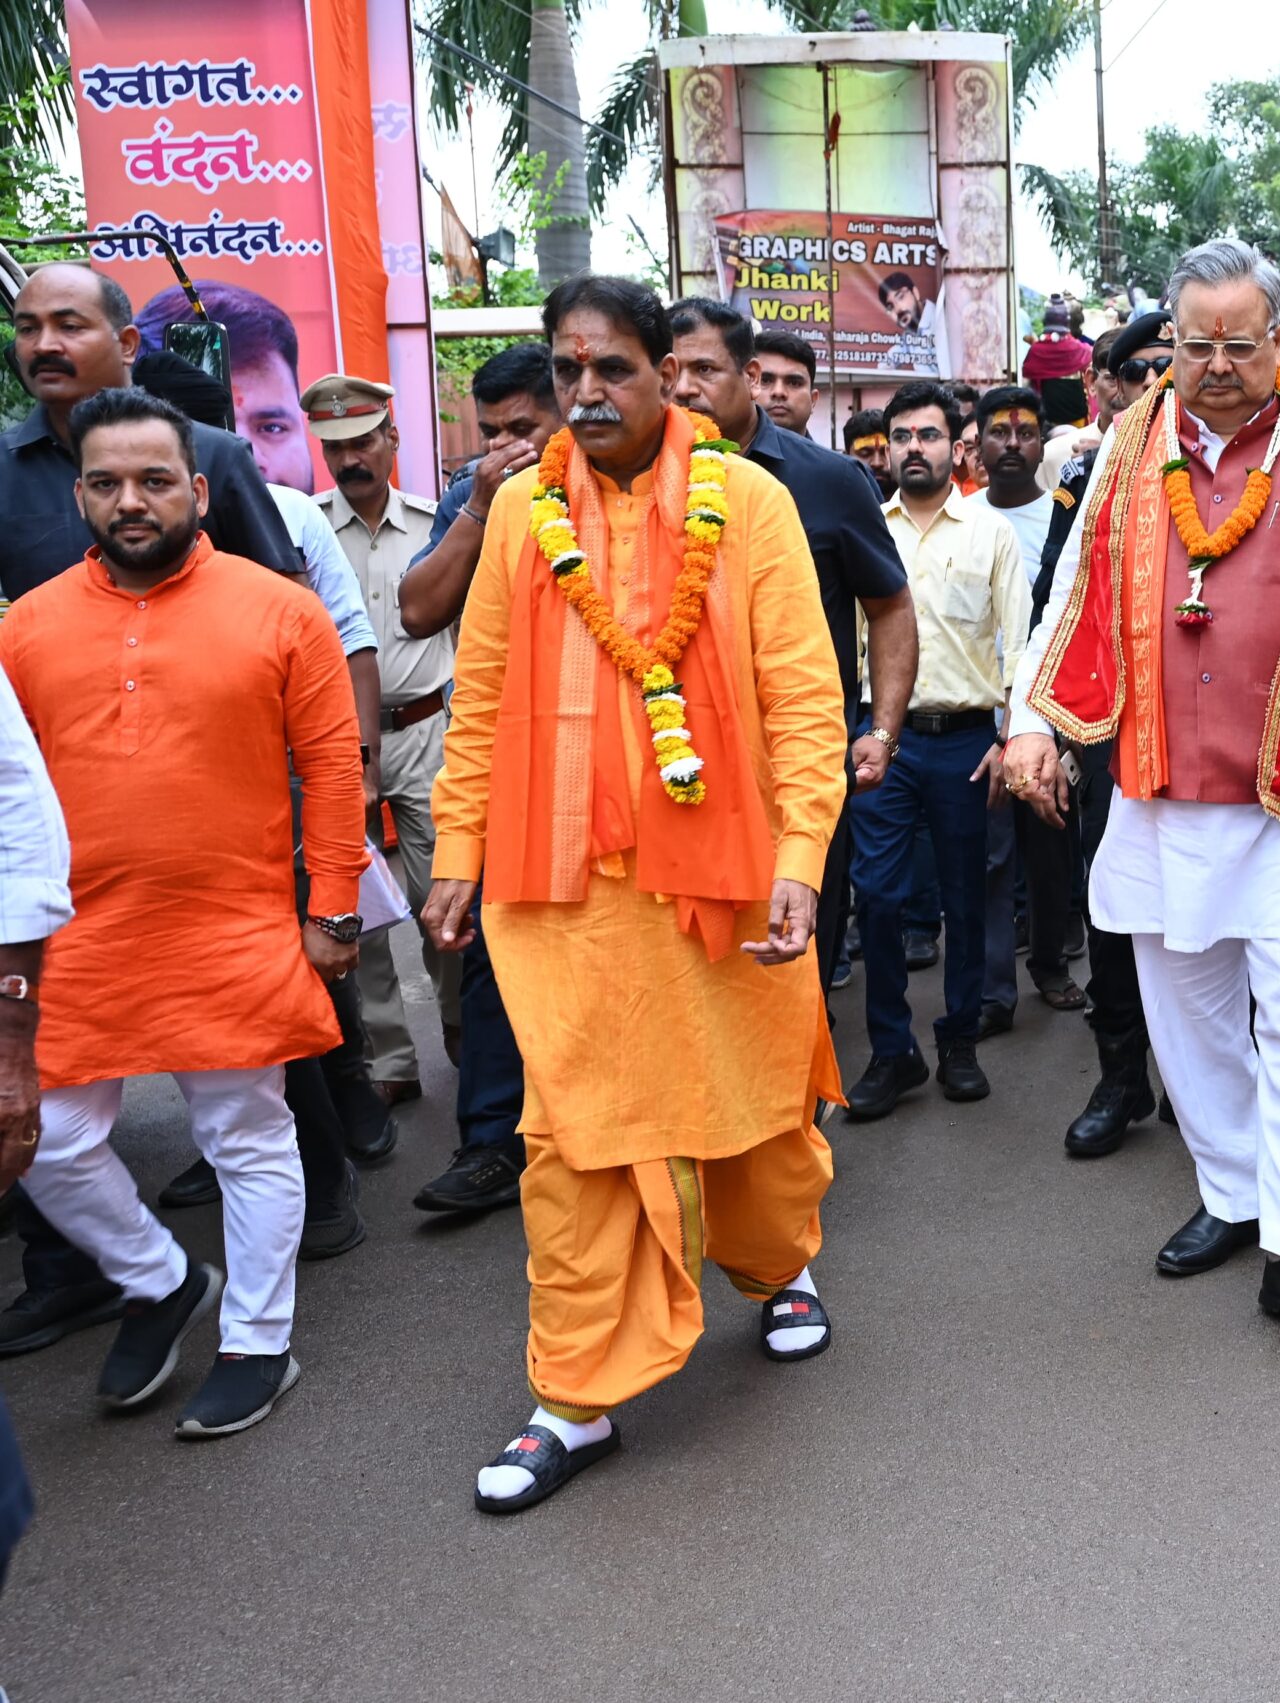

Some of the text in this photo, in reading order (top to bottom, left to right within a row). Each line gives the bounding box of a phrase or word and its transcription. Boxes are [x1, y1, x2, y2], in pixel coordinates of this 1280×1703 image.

[847, 221, 875, 234] Artist
[882, 223, 917, 238] Bhagat
[738, 236, 937, 266] GRAPHICS ARTS
[735, 266, 839, 292] Jhanki
[750, 299, 831, 322] Work
